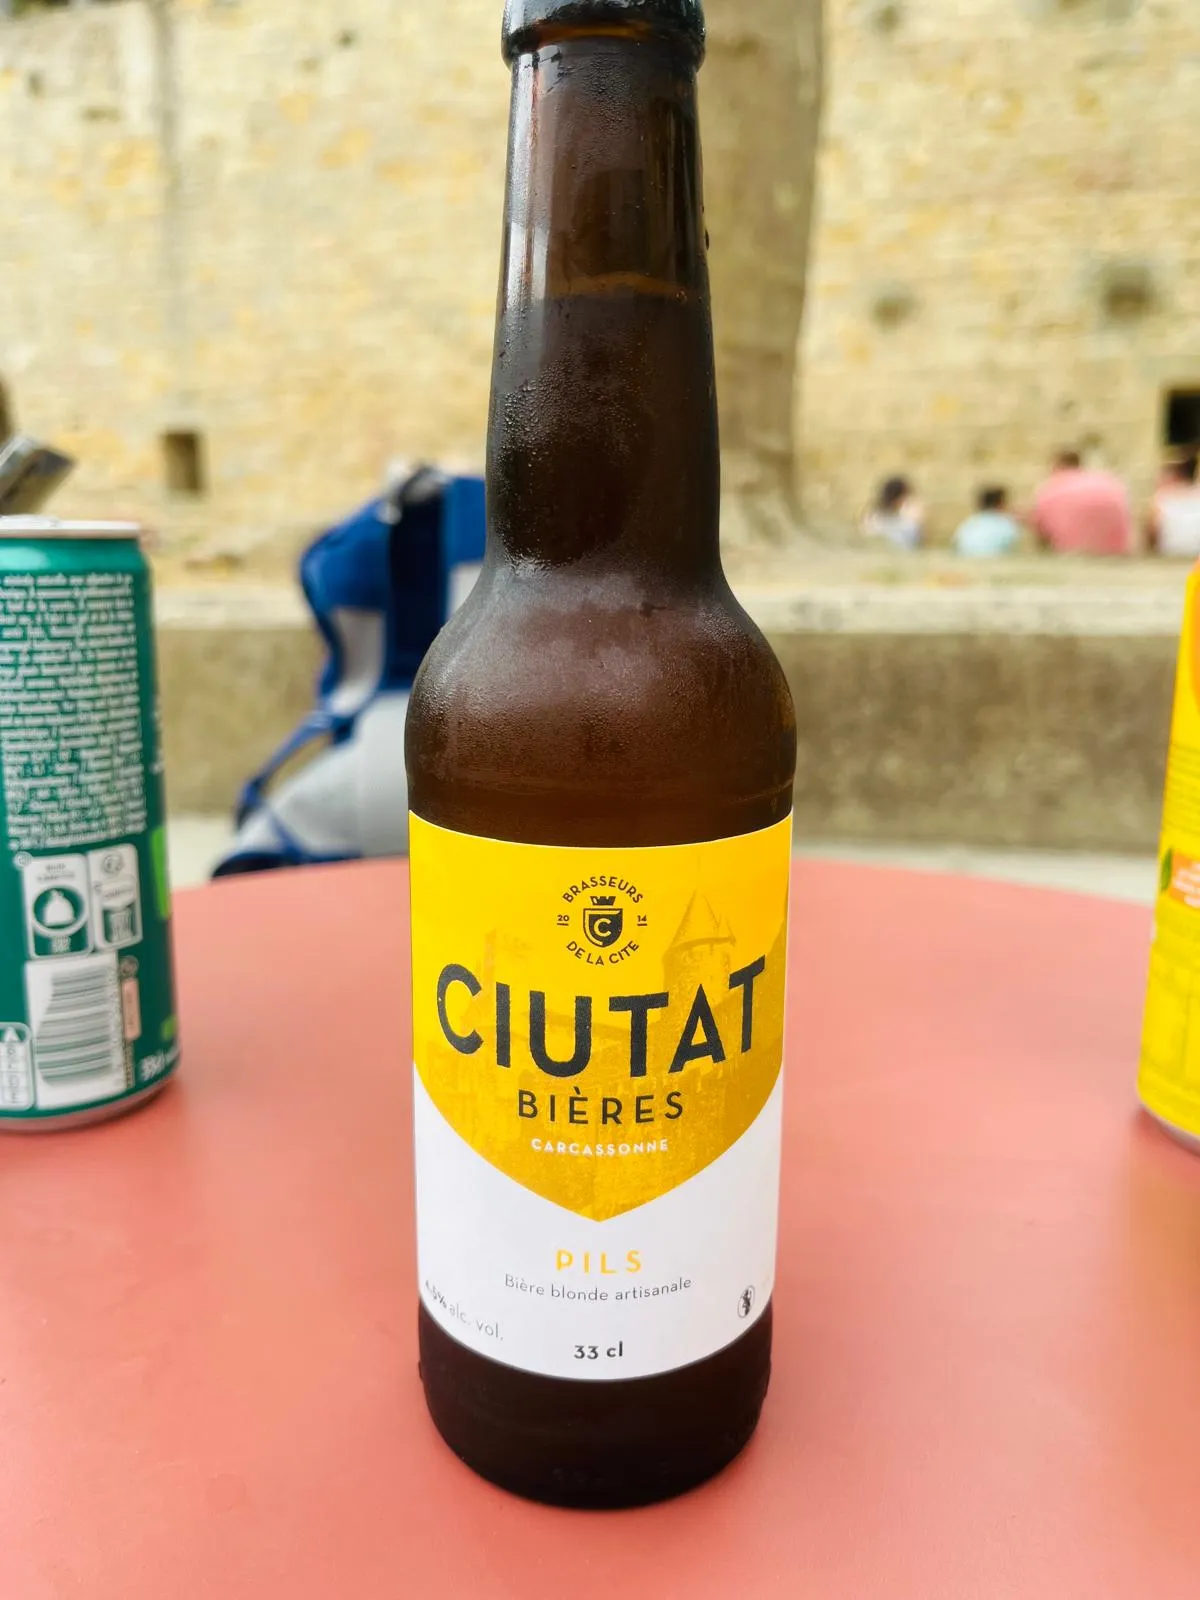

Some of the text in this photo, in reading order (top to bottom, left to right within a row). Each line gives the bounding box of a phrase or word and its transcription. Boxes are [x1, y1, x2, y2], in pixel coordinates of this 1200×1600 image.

[562, 875, 643, 903] BRASSEURS
[557, 914, 570, 922] 20
[593, 918, 611, 937] C
[637, 914, 647, 922] 14
[566, 940, 640, 966] DE LA CITE
[436, 955, 766, 1078] CIUTAT
[518, 1086, 684, 1126] BIÈRES
[530, 1137, 669, 1157] CARCASSONNE
[555, 1248, 642, 1274] PILS
[505, 1273, 692, 1301] Bière blonde artisanale
[476, 1319, 504, 1341] vol.
[574, 1340, 623, 1360] 33 cl
